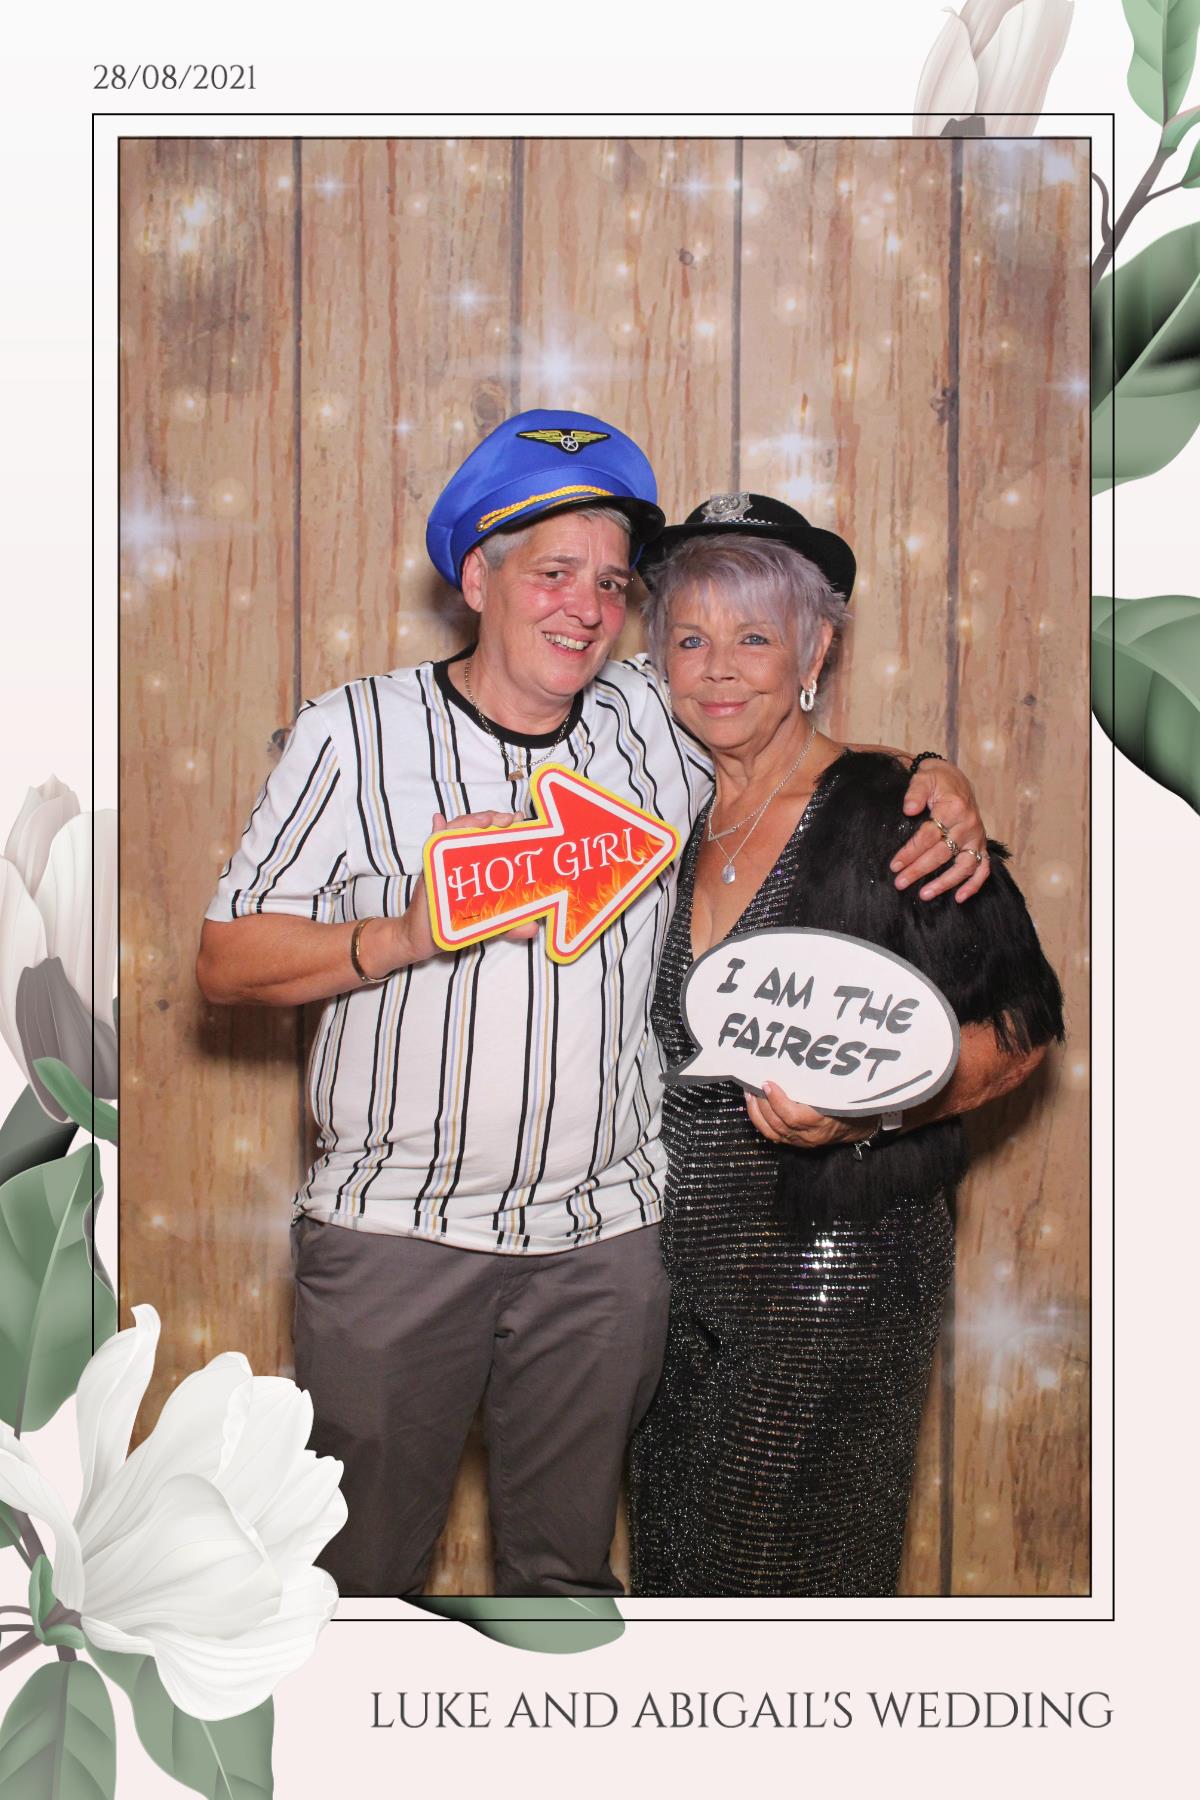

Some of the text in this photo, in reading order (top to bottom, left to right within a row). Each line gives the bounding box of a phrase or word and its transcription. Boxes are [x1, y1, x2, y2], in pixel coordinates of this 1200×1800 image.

[448, 827, 646, 901] HOT GIRL
[717, 957, 920, 1034] I AM THE
[718, 1012, 902, 1082] FAIREST
